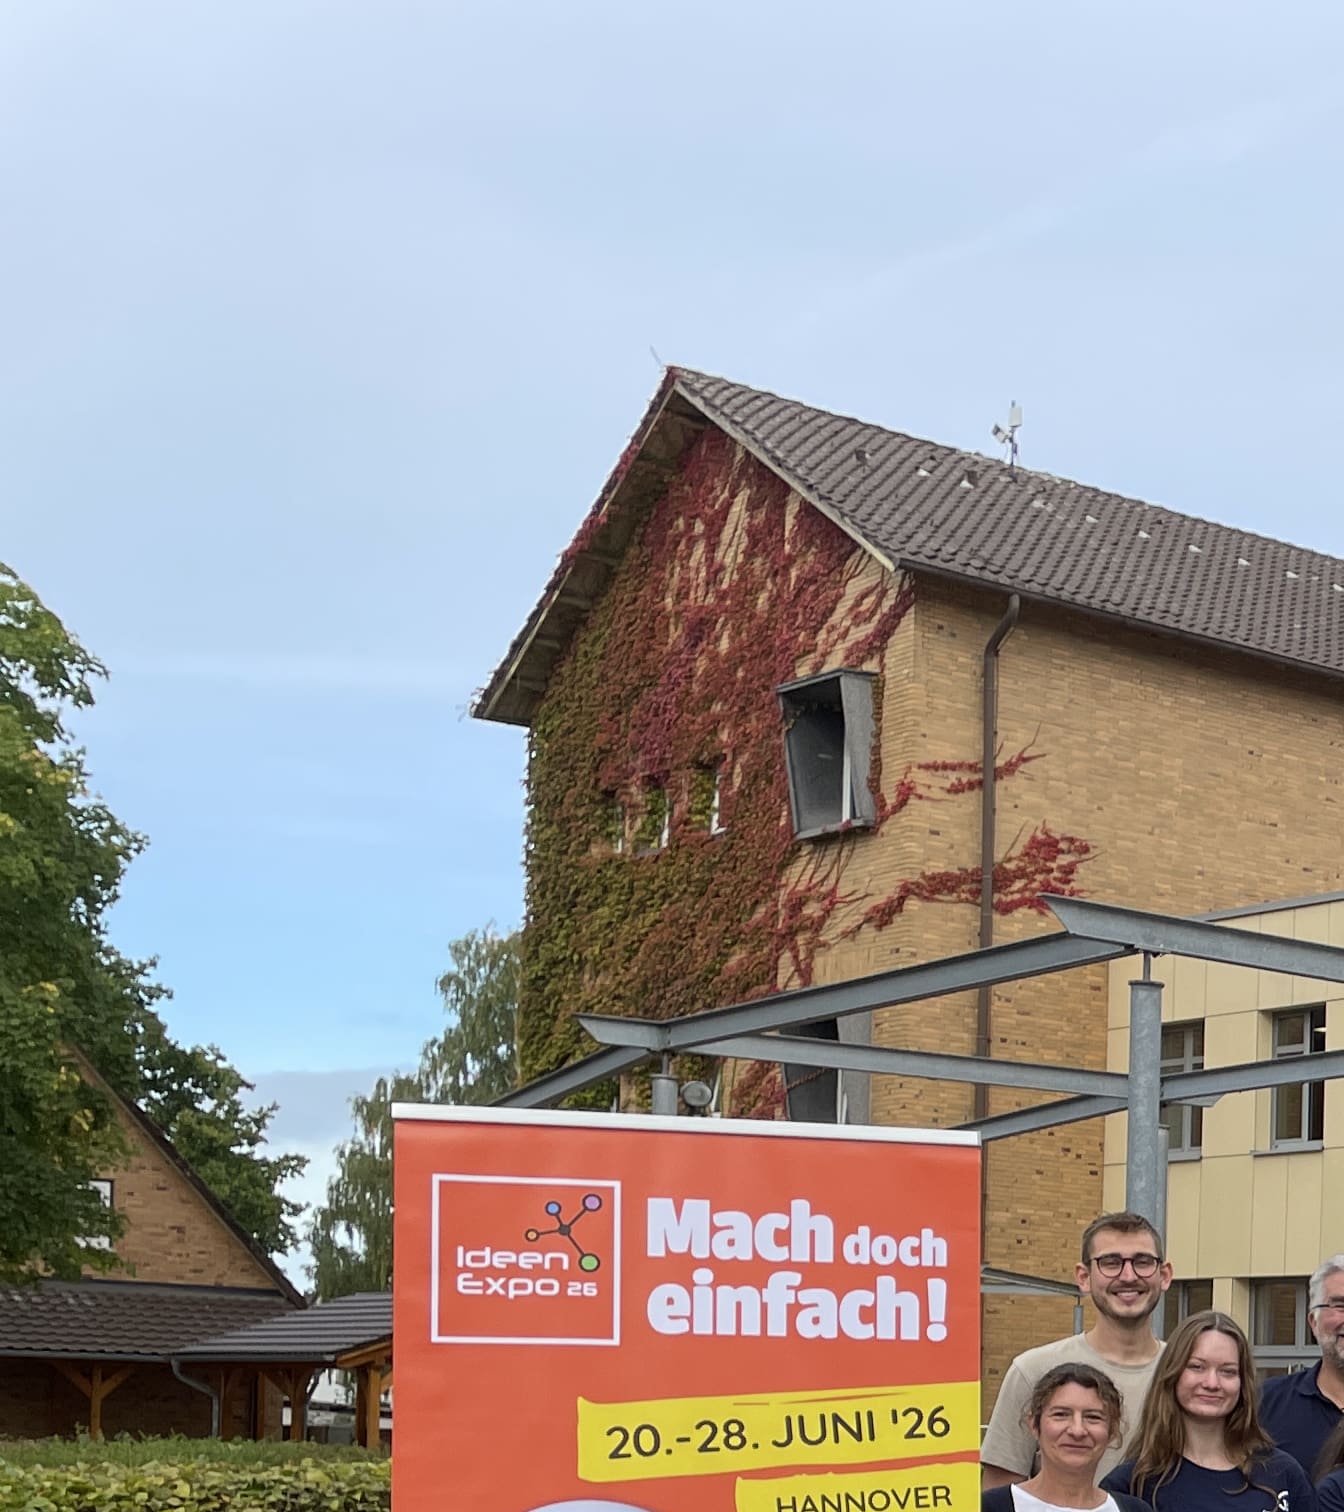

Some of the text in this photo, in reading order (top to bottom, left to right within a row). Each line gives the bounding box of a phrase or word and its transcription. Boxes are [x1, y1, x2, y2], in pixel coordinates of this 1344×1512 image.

[456, 1245, 569, 1271] Ideen
[647, 1198, 948, 1267] Mach doch
[456, 1273, 598, 1299] Expo 26
[647, 1268, 948, 1342] einfach!
[605, 1405, 952, 1461] 20.-28. JUNI '26
